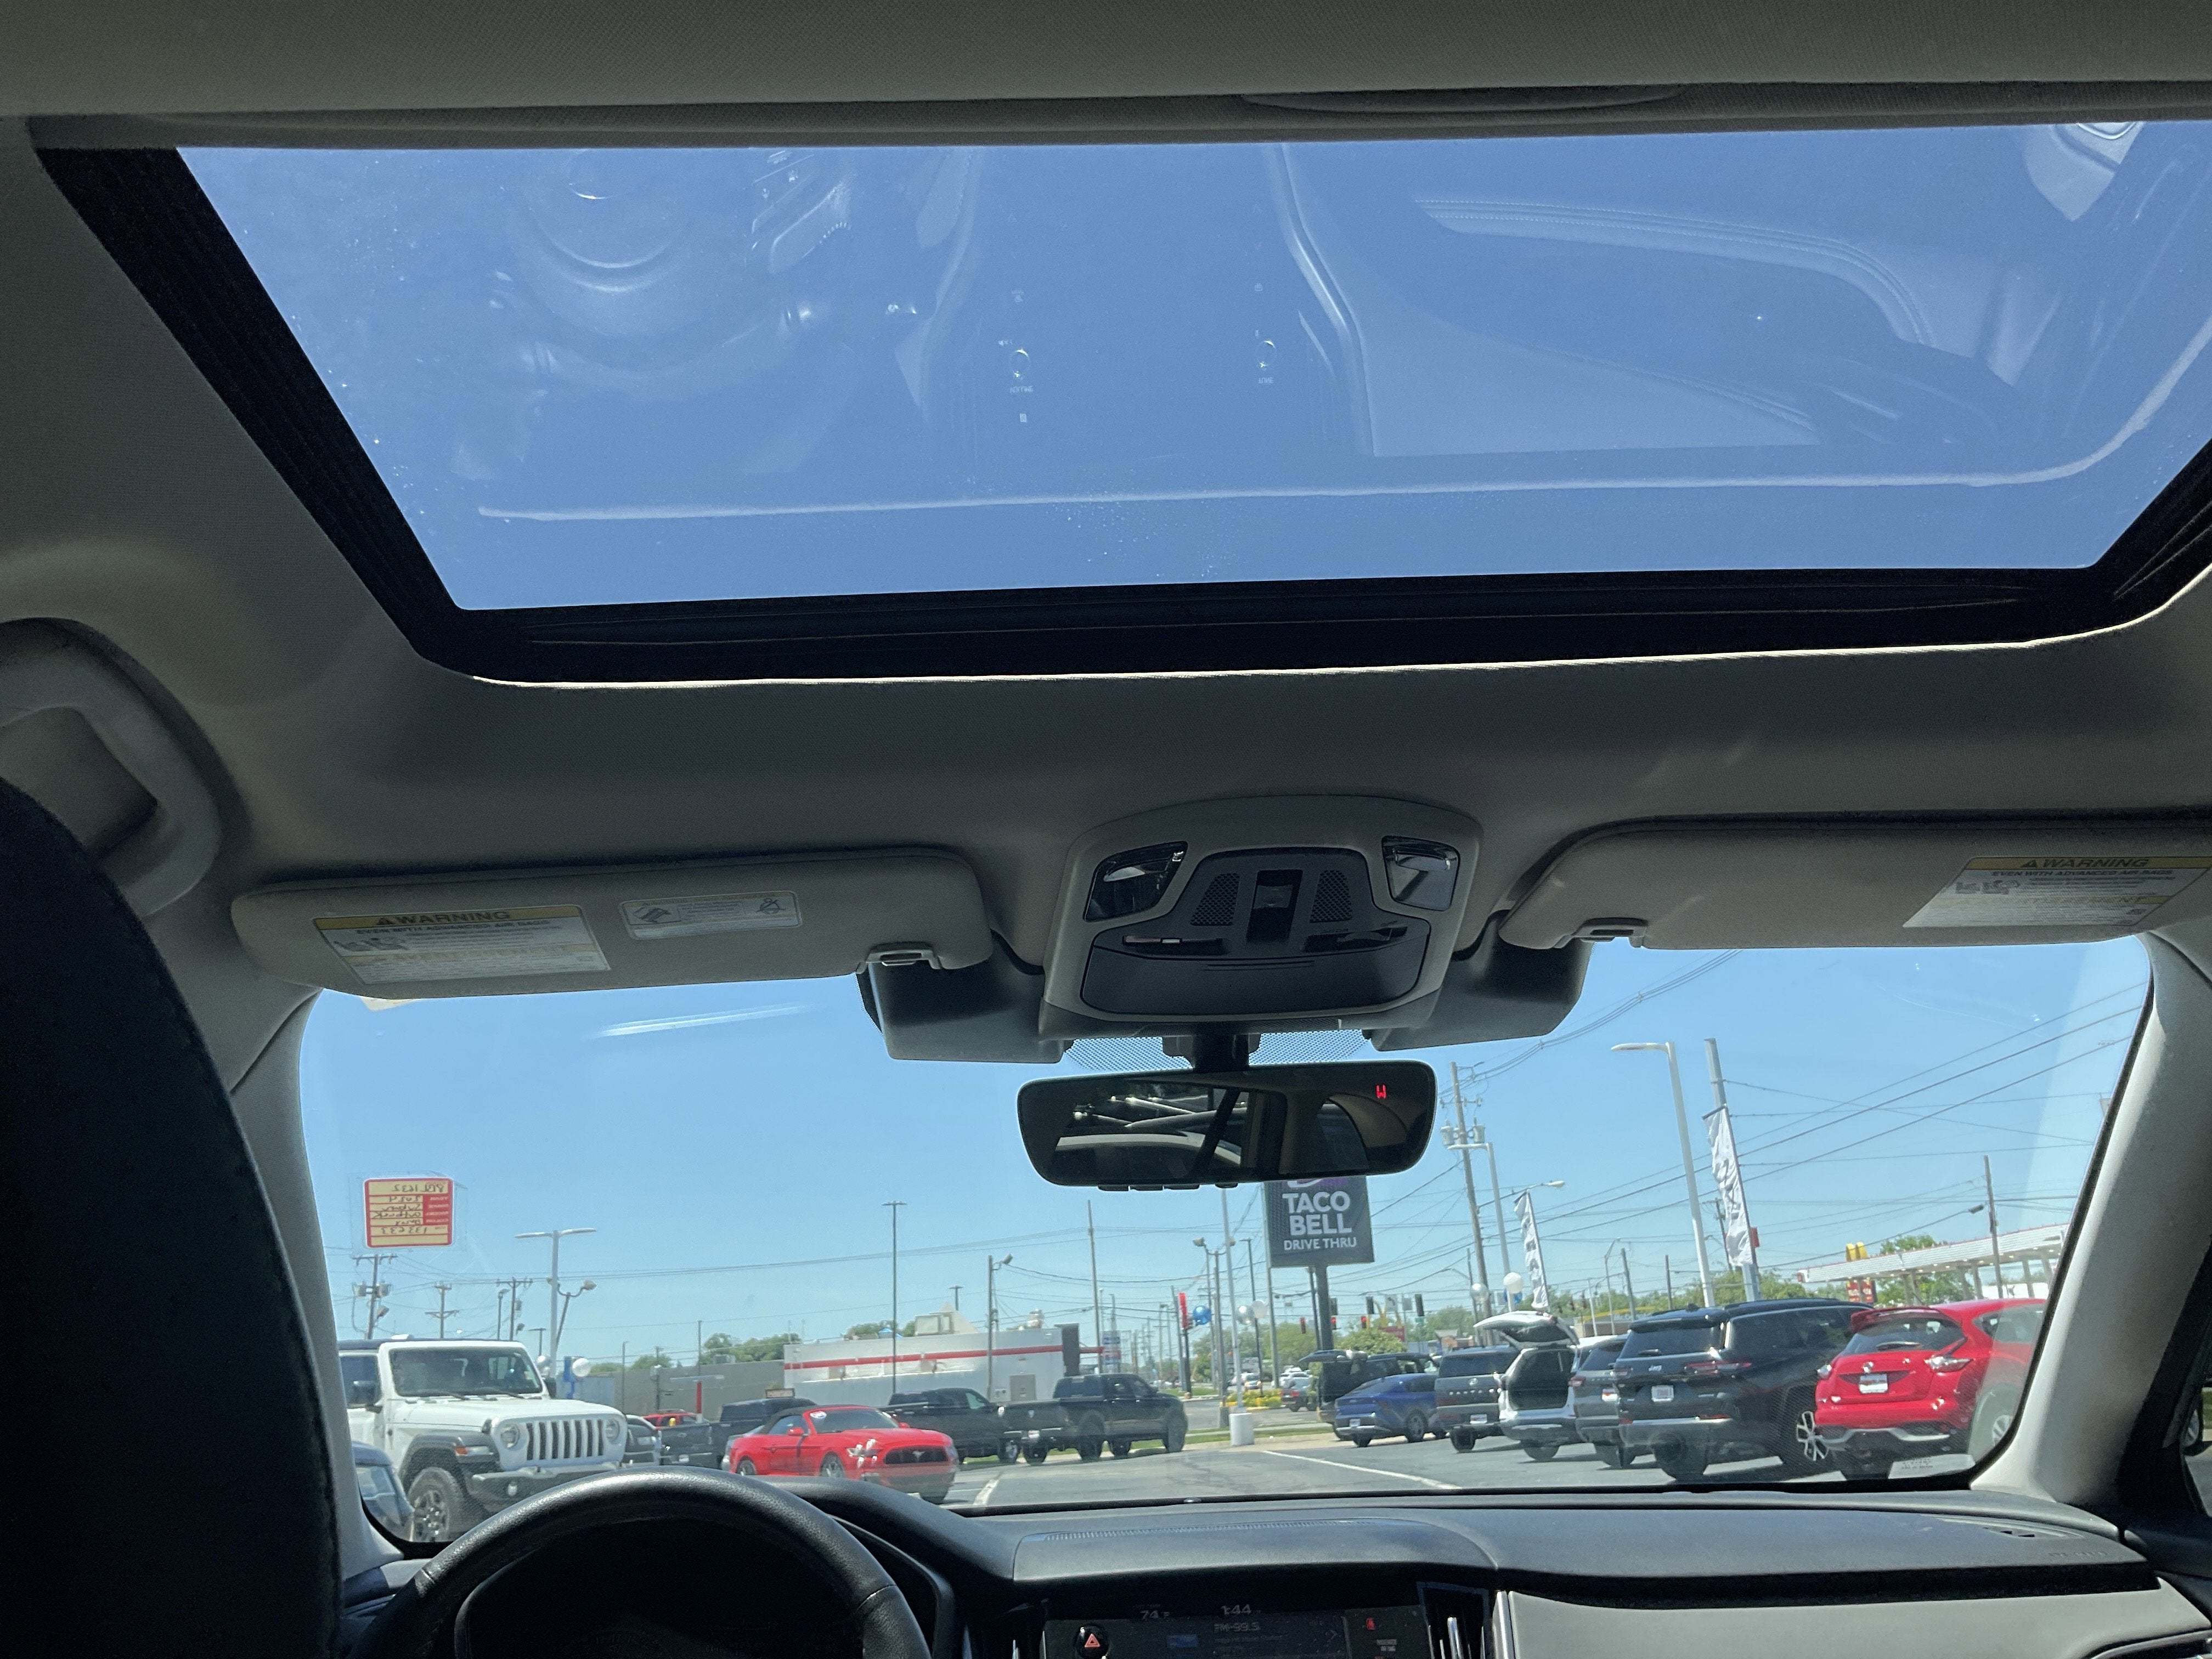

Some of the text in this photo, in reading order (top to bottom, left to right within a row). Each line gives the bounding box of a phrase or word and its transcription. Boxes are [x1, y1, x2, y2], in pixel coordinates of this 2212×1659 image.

[2042, 859, 2149, 868] WARNING
[395, 911, 510, 924] WARNING
[1282, 1190, 1350, 1214] TACO
[1289, 1213, 1352, 1236] BELL
[1284, 1237, 1357, 1251] DRIVE THRU
